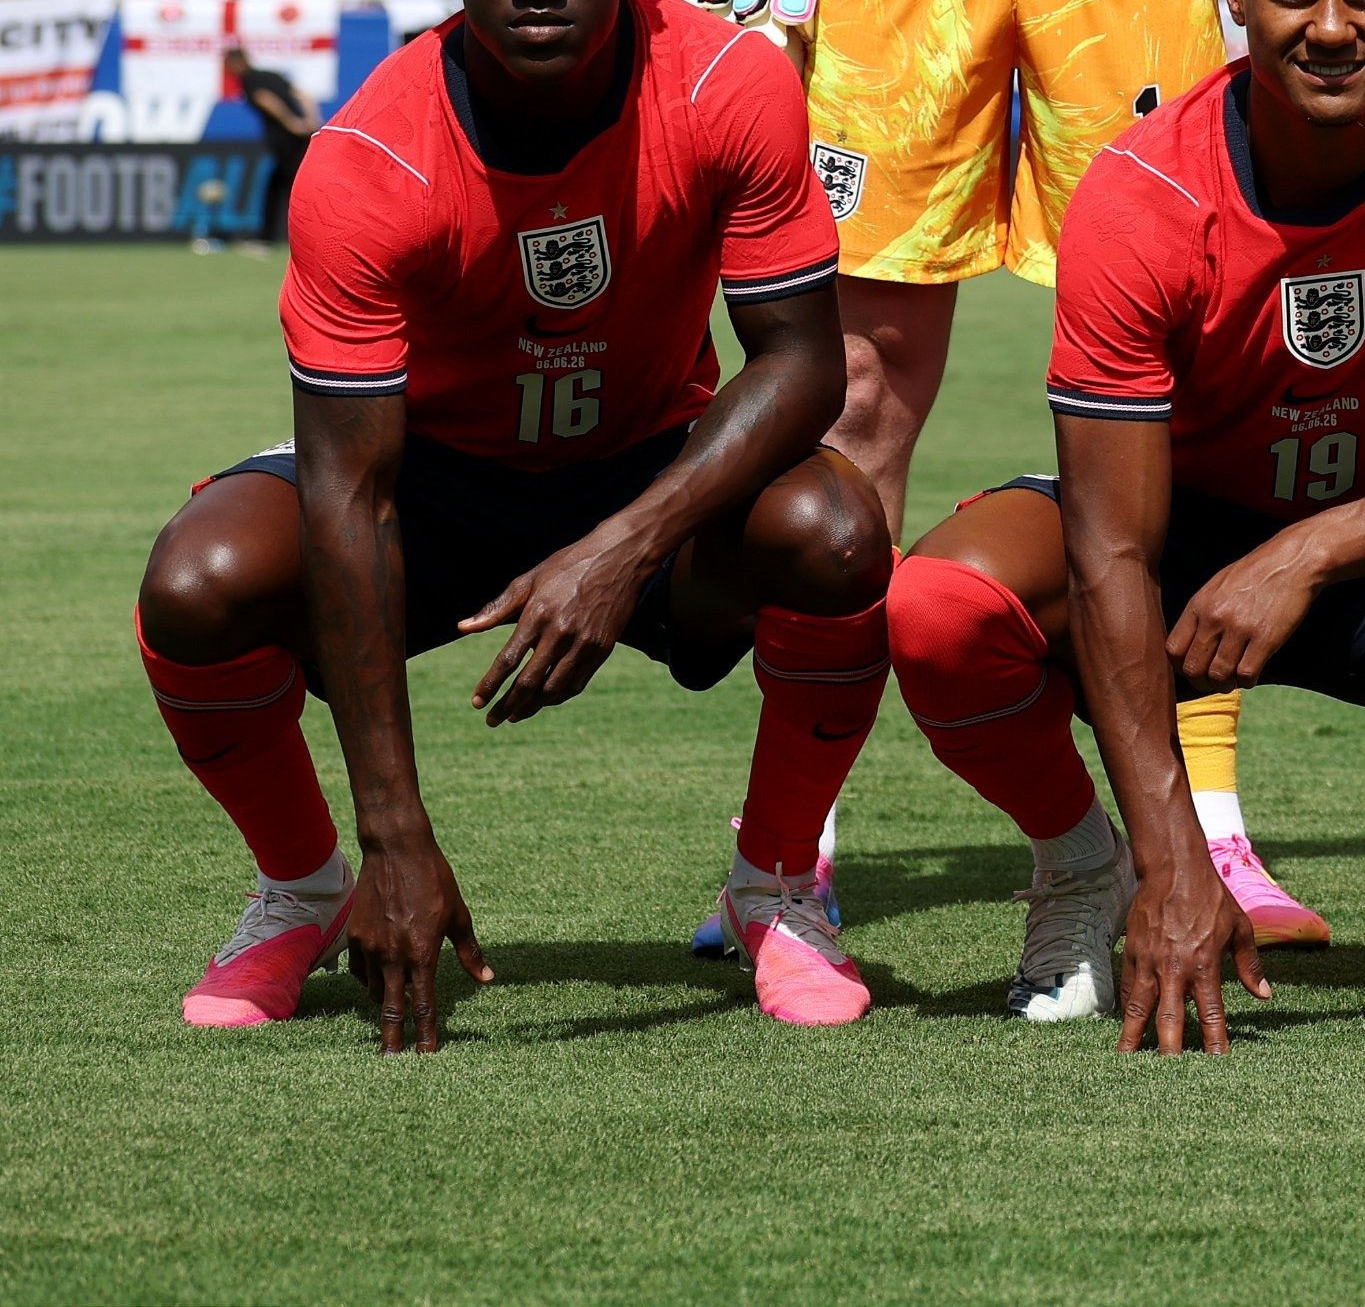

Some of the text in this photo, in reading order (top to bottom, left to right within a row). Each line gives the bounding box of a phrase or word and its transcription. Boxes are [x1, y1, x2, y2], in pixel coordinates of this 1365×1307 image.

[518, 337, 608, 358] NEW ZEALAND
[536, 356, 585, 369] 06.06.26
[516, 369, 601, 443] 16
[1272, 397, 1360, 422] NEW ZEALAND
[1291, 414, 1338, 432] 06.06.26
[1270, 431, 1357, 501] 19
